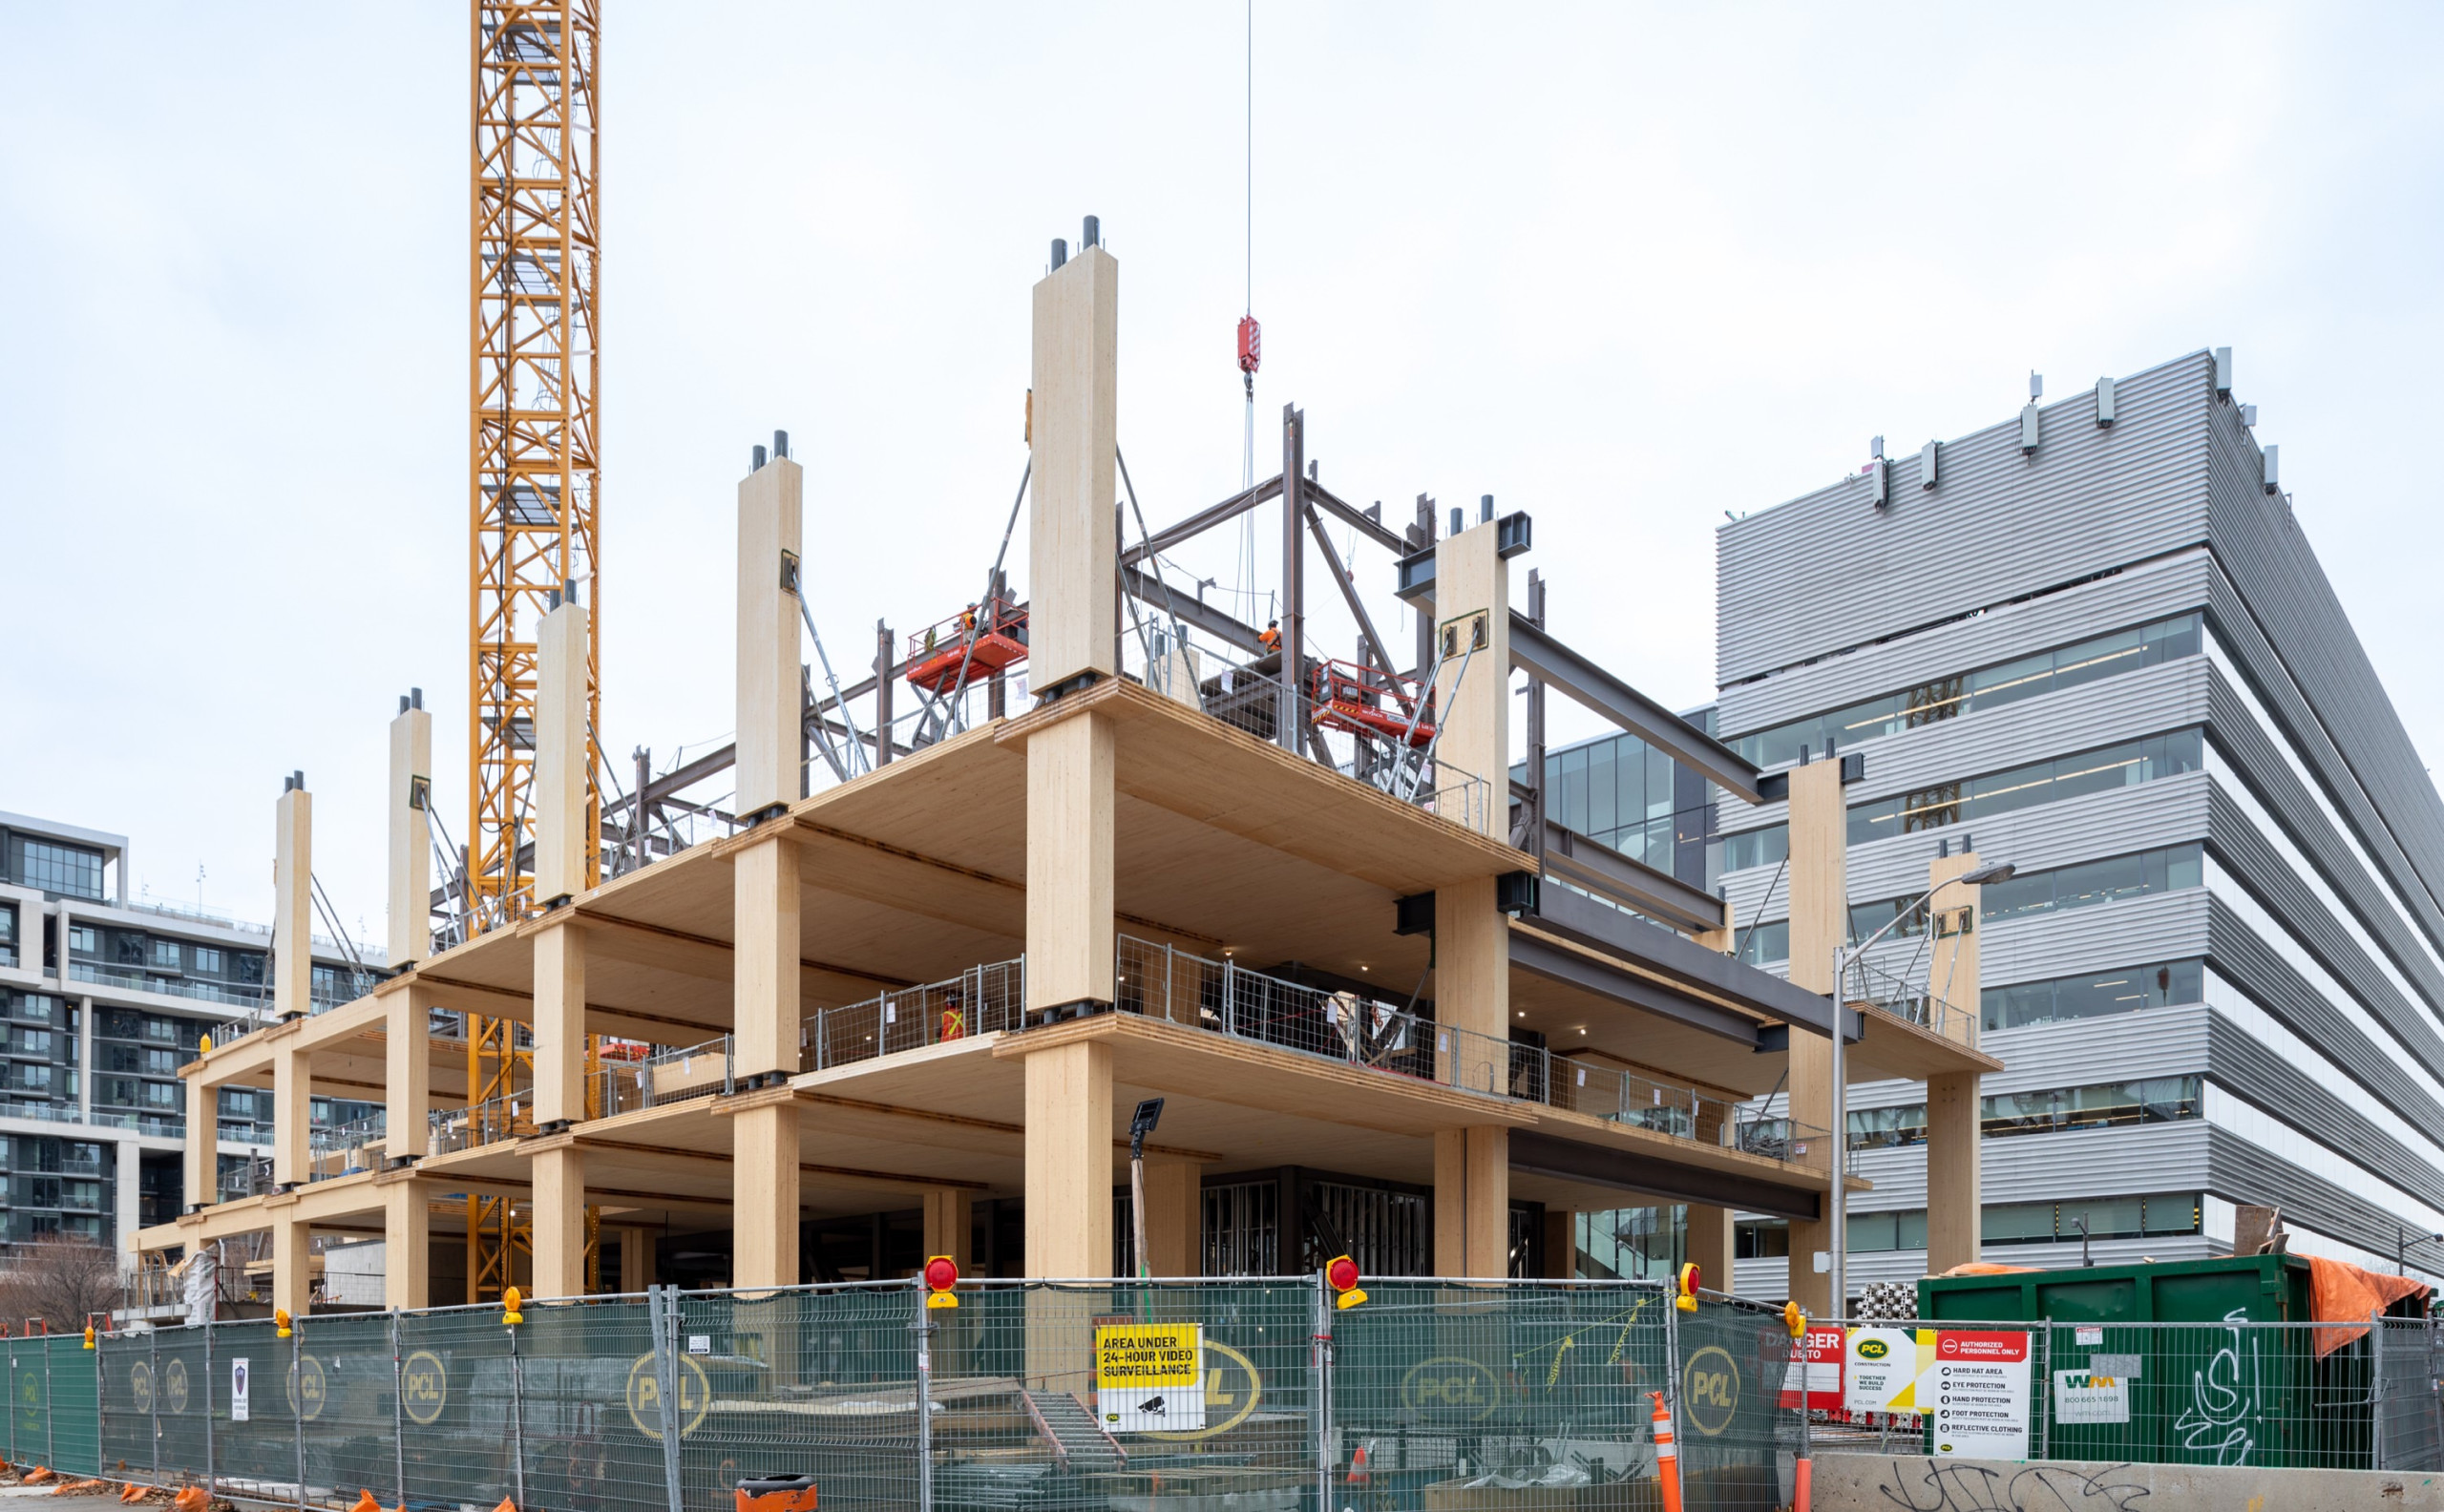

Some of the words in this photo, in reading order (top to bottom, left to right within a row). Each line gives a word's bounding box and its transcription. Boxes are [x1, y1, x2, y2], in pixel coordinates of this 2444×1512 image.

[1104, 1337, 1134, 1349] AREA
[1138, 1336, 1177, 1348] UNDER
[1862, 1344, 1884, 1354] PCL
[1104, 1351, 1156, 1363] 24-HOUR
[1159, 1350, 1193, 1361] VIDEO
[1807, 1350, 1822, 1359] TO
[1104, 1364, 1191, 1377] SURVEILLANCE
[135, 1376, 149, 1396] PCL
[408, 1374, 439, 1400] PCL
[2065, 1375, 2116, 1389] WM
[638, 1376, 694, 1411] PL
[1417, 1376, 1482, 1404] PCL
[1692, 1371, 1732, 1408] PCL
